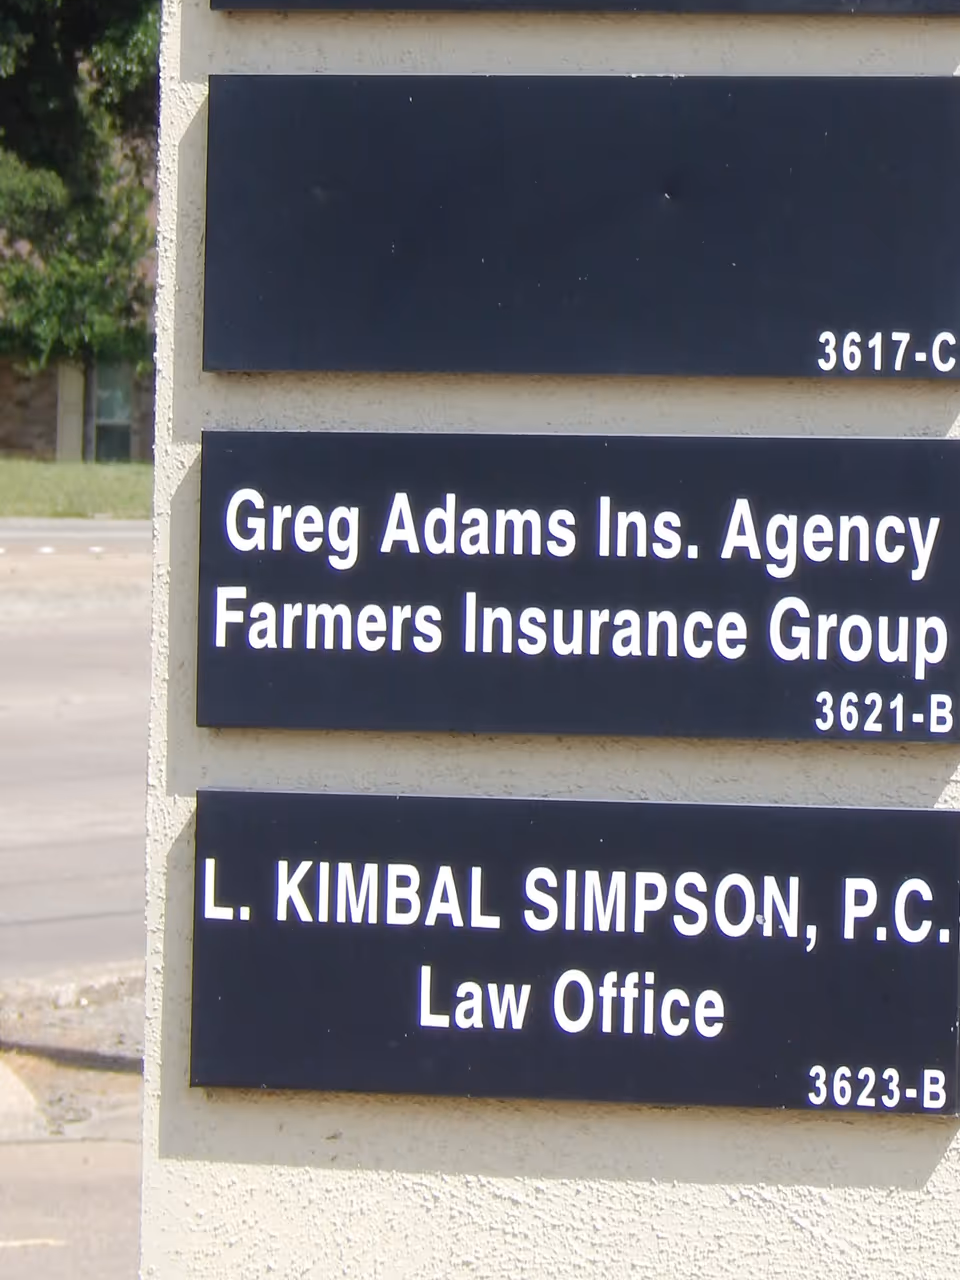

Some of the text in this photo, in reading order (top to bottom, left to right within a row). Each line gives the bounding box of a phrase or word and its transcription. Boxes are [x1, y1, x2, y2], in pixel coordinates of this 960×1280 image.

[817, 330, 957, 374] 3617-C
[225, 487, 943, 581] Greg Adams Ins. Agency
[213, 585, 949, 681] Farmers Insurance Group
[814, 690, 954, 734] 3621-B
[204, 857, 951, 953] L. KIMBAL SIMPSON, P.C.
[419, 964, 725, 1038] Law Office
[807, 1064, 947, 1109] 3623-B
